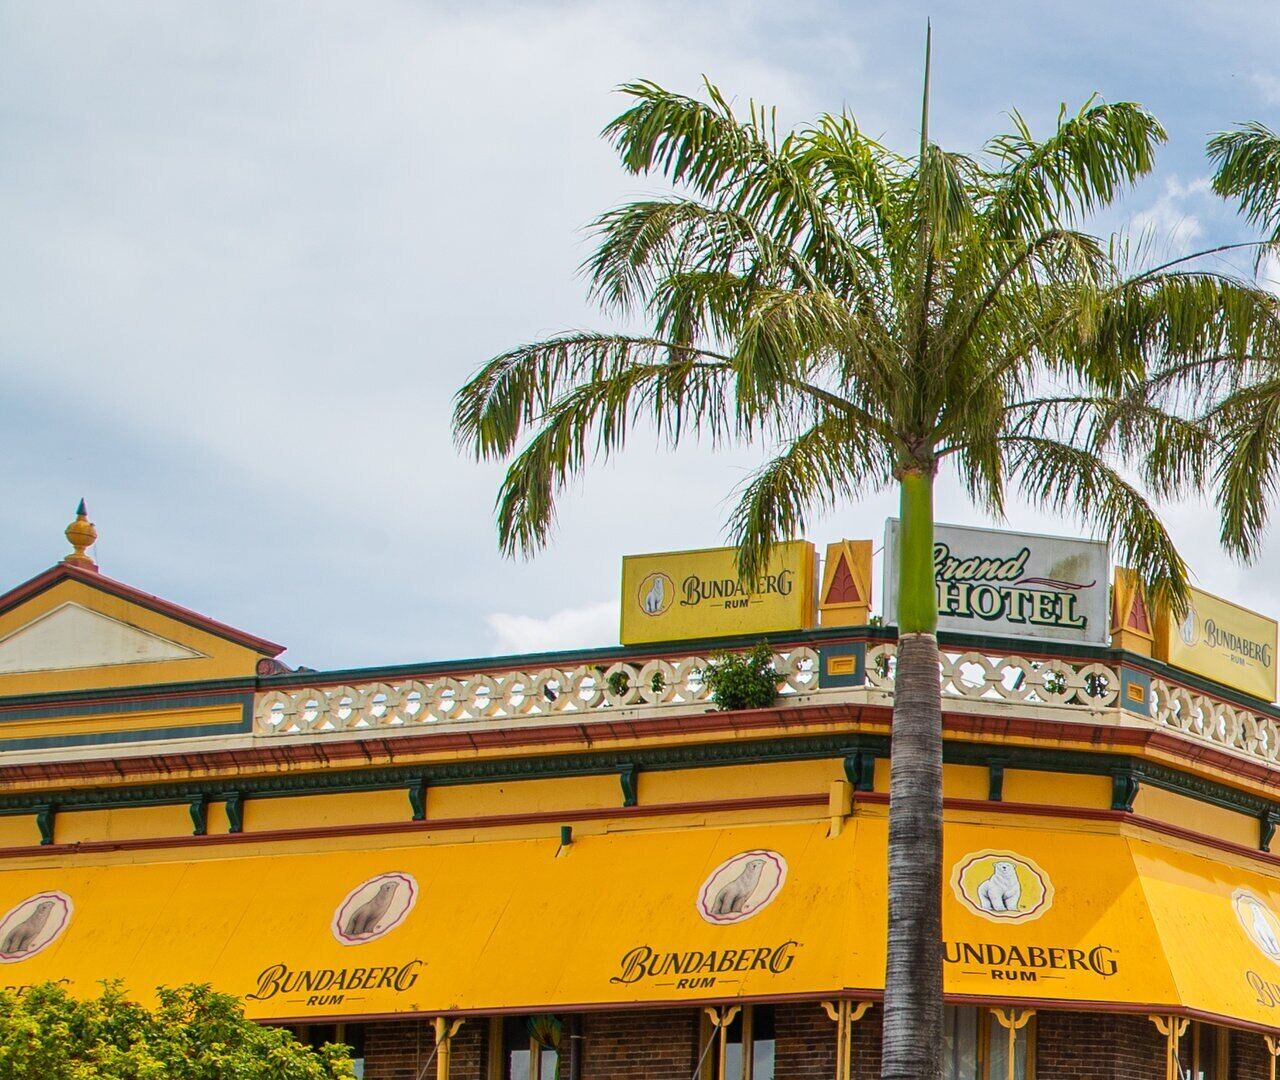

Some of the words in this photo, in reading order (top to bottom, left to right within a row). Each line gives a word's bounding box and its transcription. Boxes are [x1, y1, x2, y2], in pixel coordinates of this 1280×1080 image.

[680, 569, 793, 607] BUNDAERG
[724, 599, 749, 610] RUM
[936, 581, 1088, 630] HOTEL
[1204, 618, 1272, 669] BUNDABERG
[1230, 654, 1246, 667] RUM
[609, 940, 799, 985] BUNDABERG
[943, 941, 1118, 977] UNDABERG
[990, 969, 1038, 982] RUM
[245, 960, 423, 1001] BUNDABERG
[676, 977, 716, 990] RUM
[306, 994, 345, 1007] RUM
